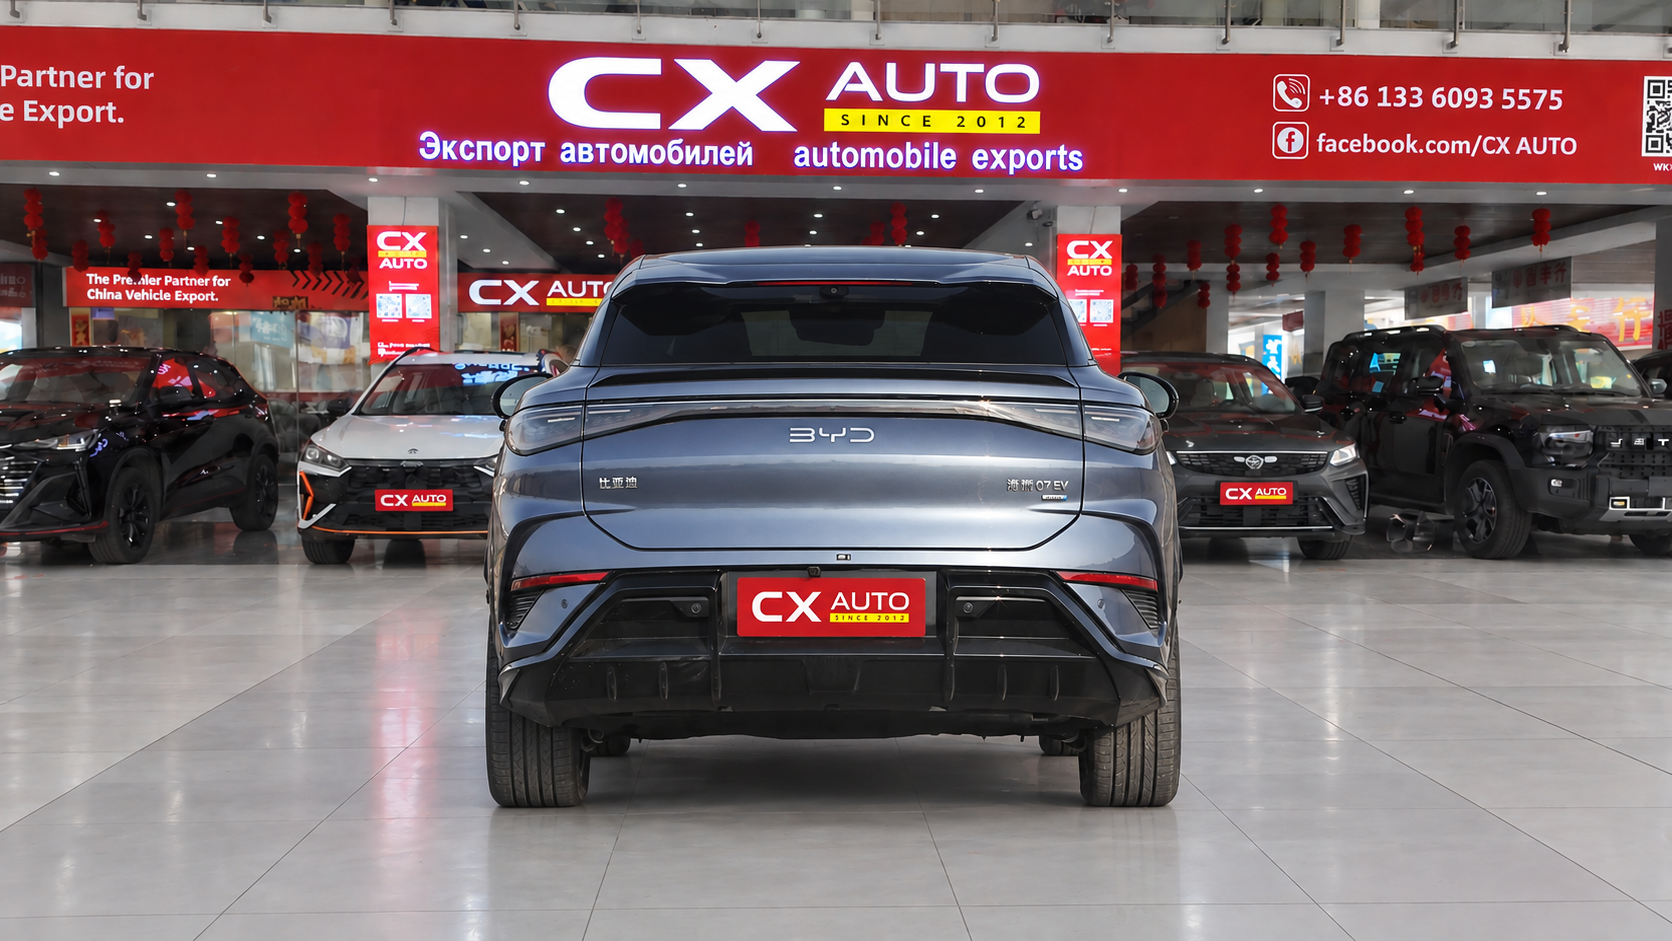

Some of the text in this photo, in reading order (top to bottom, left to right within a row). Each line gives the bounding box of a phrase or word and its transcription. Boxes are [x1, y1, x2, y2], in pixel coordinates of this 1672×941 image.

[1, 65, 155, 89] Partner for
[826, 61, 1040, 103] AUTO
[548, 56, 801, 132] CX
[1319, 86, 1564, 110] +86 133 6093 5575
[23, 100, 125, 129] Export.
[841, 114, 1026, 129] SINCE 2012
[419, 131, 754, 167] Экспорт автомобилей
[1316, 133, 1578, 157] facebook.com/CX AUTO
[794, 141, 1084, 175] automobile exports
[1653, 162, 1672, 171] WK
[376, 231, 427, 251] CX
[1066, 240, 1113, 259] CX
[379, 258, 428, 270] AUTO
[1067, 265, 1112, 276] AUTO
[86, 273, 110, 285] The
[164, 275, 211, 287] Partner
[212, 275, 232, 287] for
[87, 288, 219, 304] China Vehicle Export.
[468, 279, 540, 306] CX
[789, 427, 875, 443] BYD
[599, 476, 638, 490] 比亚迪
[380, 494, 447, 507] CX AUTO
[1225, 487, 1287, 500] CX AUTO
[751, 591, 910, 623] CX AUTO
